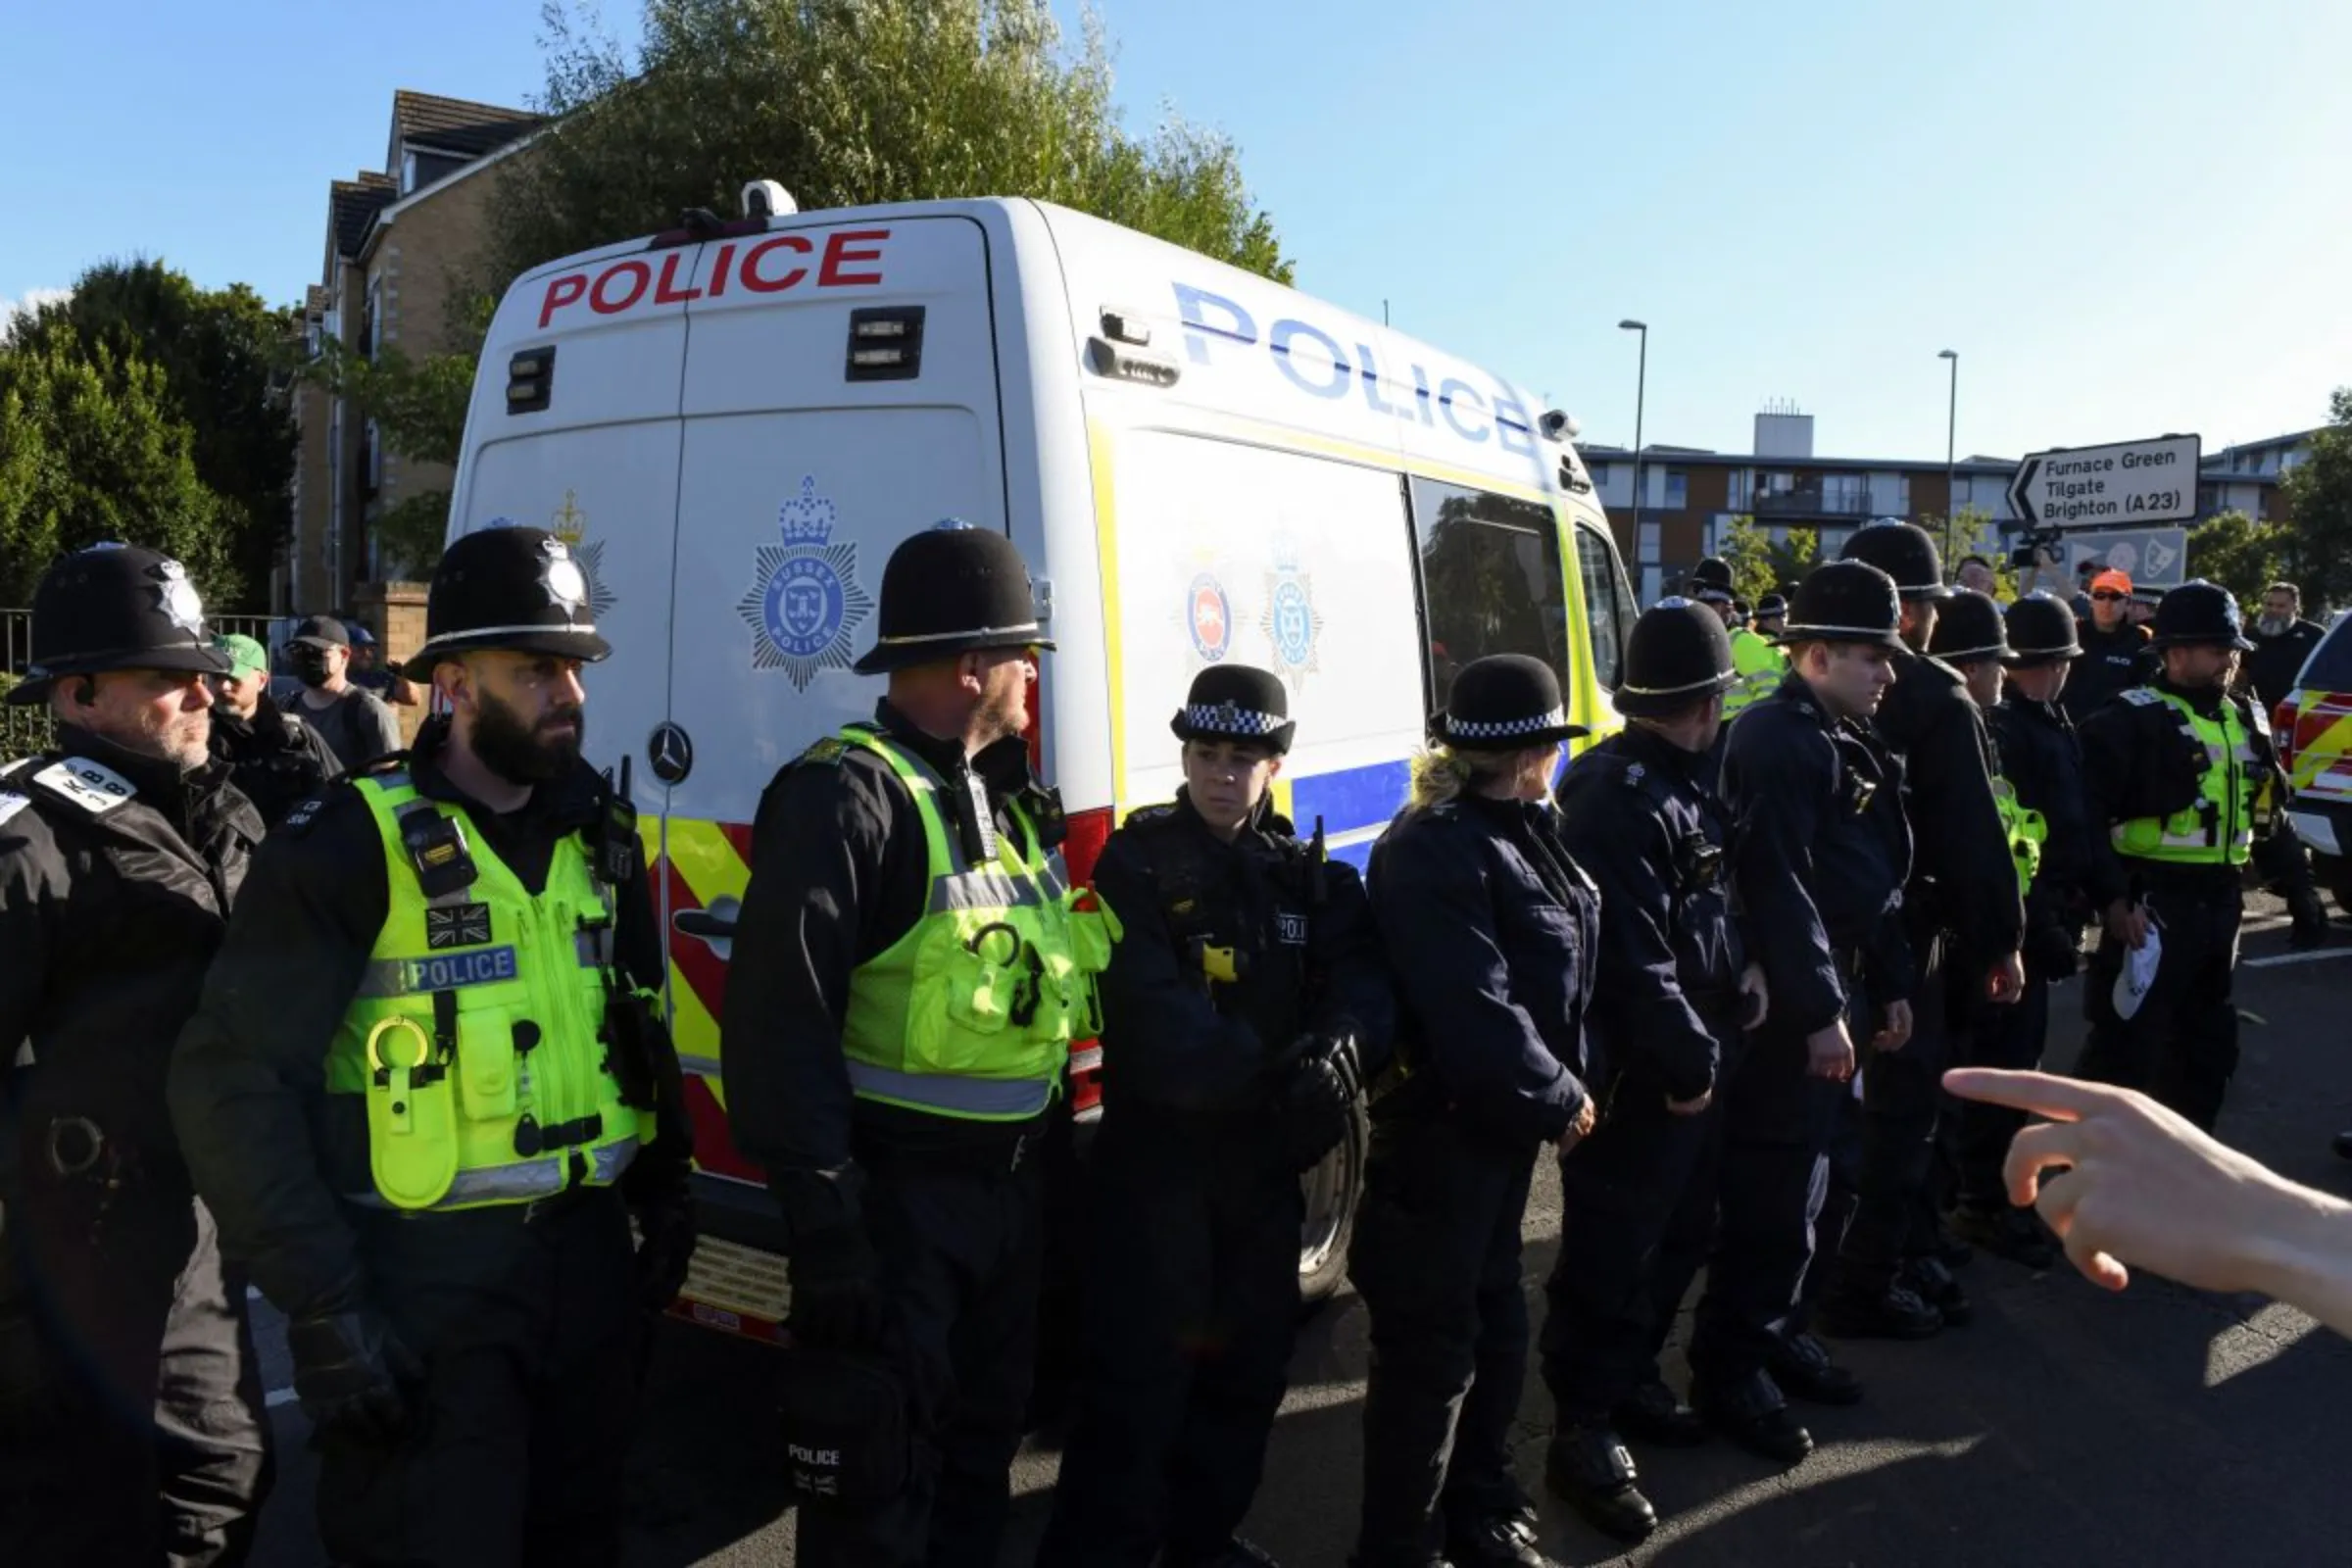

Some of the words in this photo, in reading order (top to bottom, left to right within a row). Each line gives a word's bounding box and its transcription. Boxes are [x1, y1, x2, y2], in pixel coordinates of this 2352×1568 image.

[538, 229, 890, 328] POLICE
[1173, 282, 1534, 458] POLICE
[2045, 458, 2114, 477] Furnace
[2122, 452, 2176, 468] Green
[2046, 480, 2105, 499] Tilgate
[2044, 500, 2118, 519] Brighton
[2125, 490, 2180, 514] (A23)
[409, 951, 514, 987] POLICE
[789, 1444, 840, 1465] POLICE
